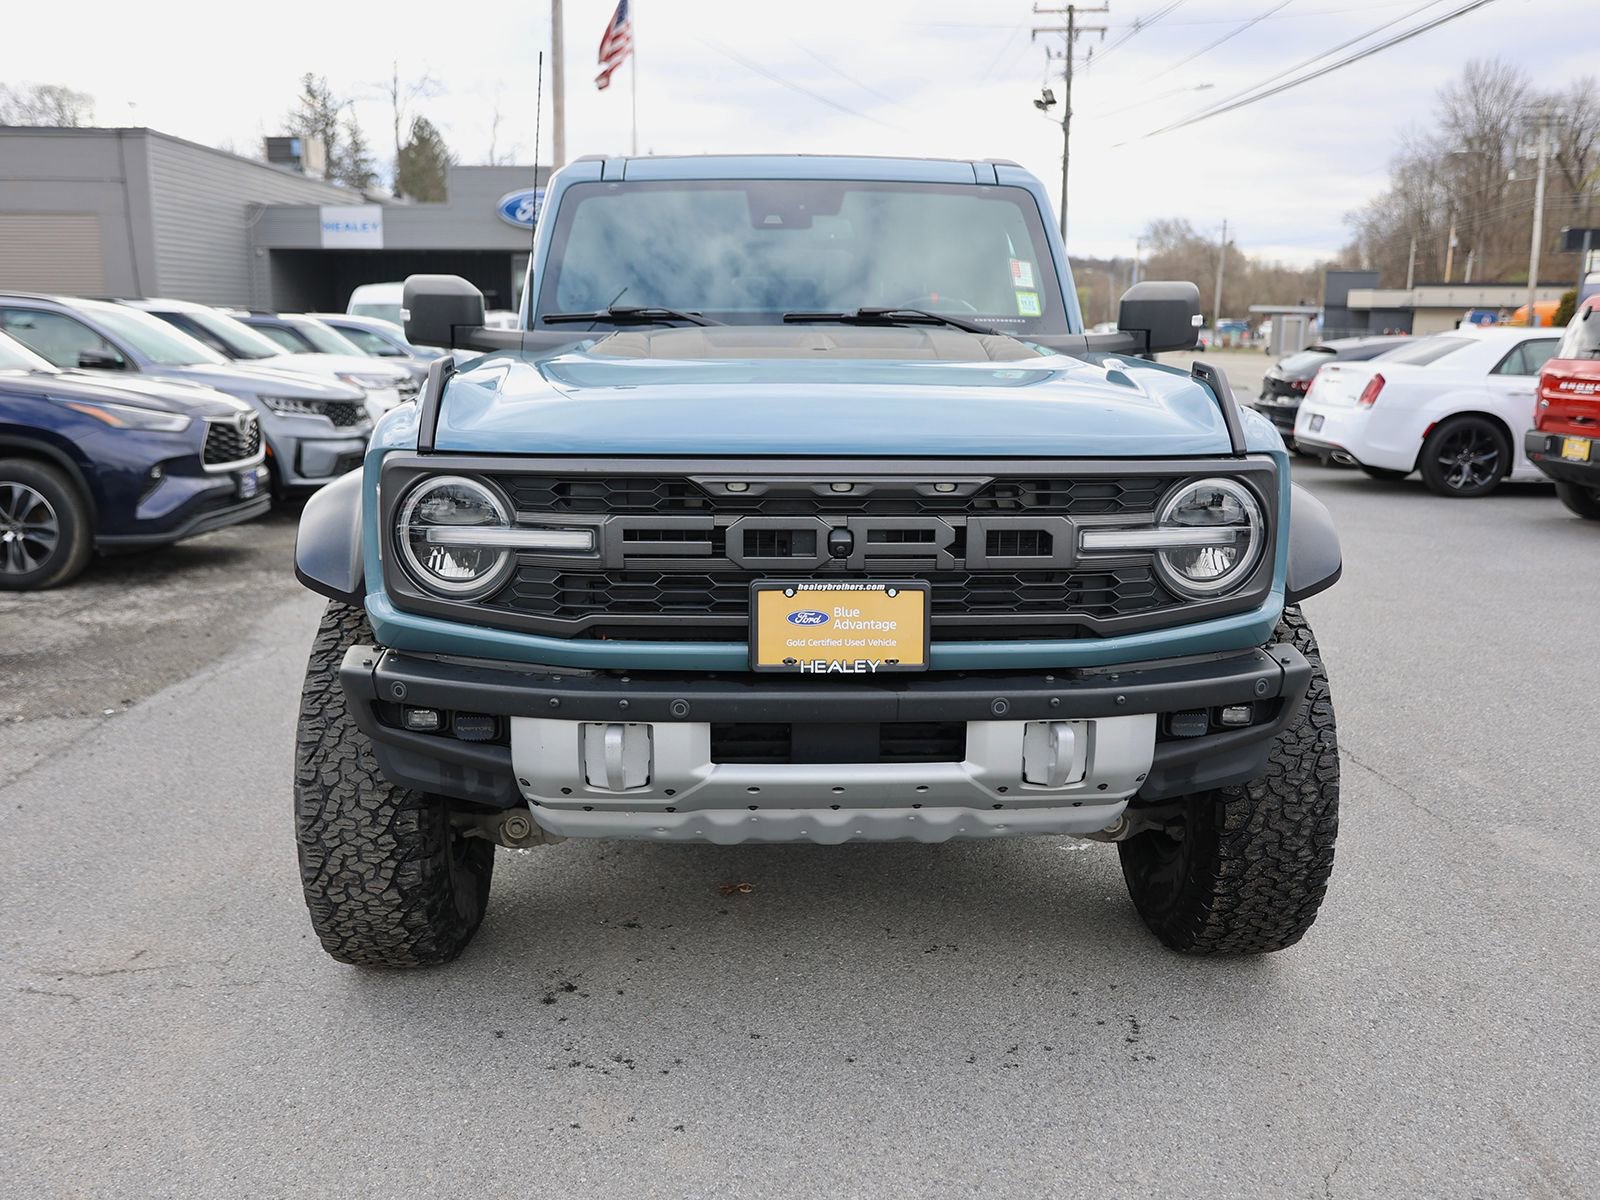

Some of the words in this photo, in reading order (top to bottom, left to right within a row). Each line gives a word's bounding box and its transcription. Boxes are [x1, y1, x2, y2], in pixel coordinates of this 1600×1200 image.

[322, 222, 380, 233] HEALEY
[604, 515, 1074, 570] FORD
[798, 583, 885, 591] healeybrothers.com
[793, 611, 823, 625] Ford
[833, 606, 860, 618] Blue
[833, 618, 897, 631] Advantage
[786, 639, 805, 647] Gold
[807, 638, 842, 647] Certified
[844, 639, 866, 647] Used
[867, 639, 897, 647] Vehicle
[800, 659, 880, 674] HEALEY
